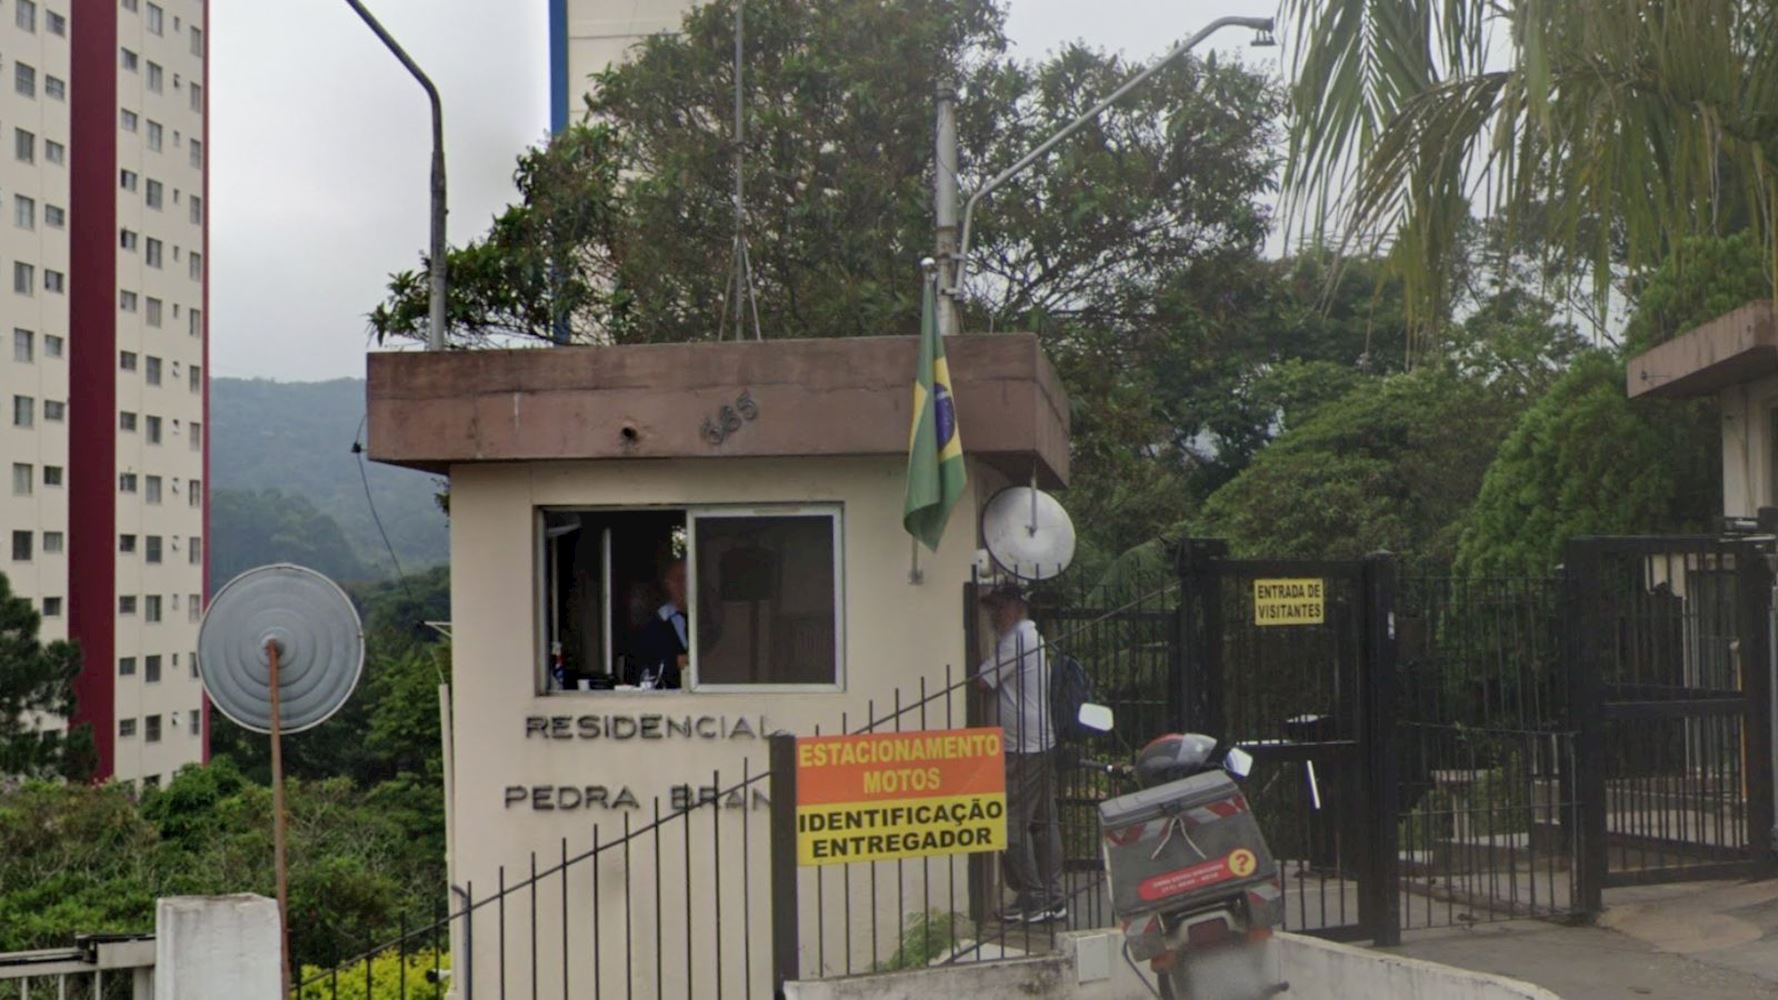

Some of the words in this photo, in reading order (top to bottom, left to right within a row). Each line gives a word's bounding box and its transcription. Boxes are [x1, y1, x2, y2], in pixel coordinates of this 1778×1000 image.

[1258, 584, 1305, 599] ENTRADA
[1308, 584, 1320, 598] DE
[1258, 604, 1321, 619] VISITANTES
[526, 715, 770, 740] RESIDENCIAL
[800, 734, 1000, 768] ESTACIONAMENTO
[864, 768, 941, 794] MOTOS
[505, 786, 640, 811] PEDRA
[800, 799, 1003, 833] IDENTIFICAÇÃO
[813, 827, 991, 858] ENTREGADOR
